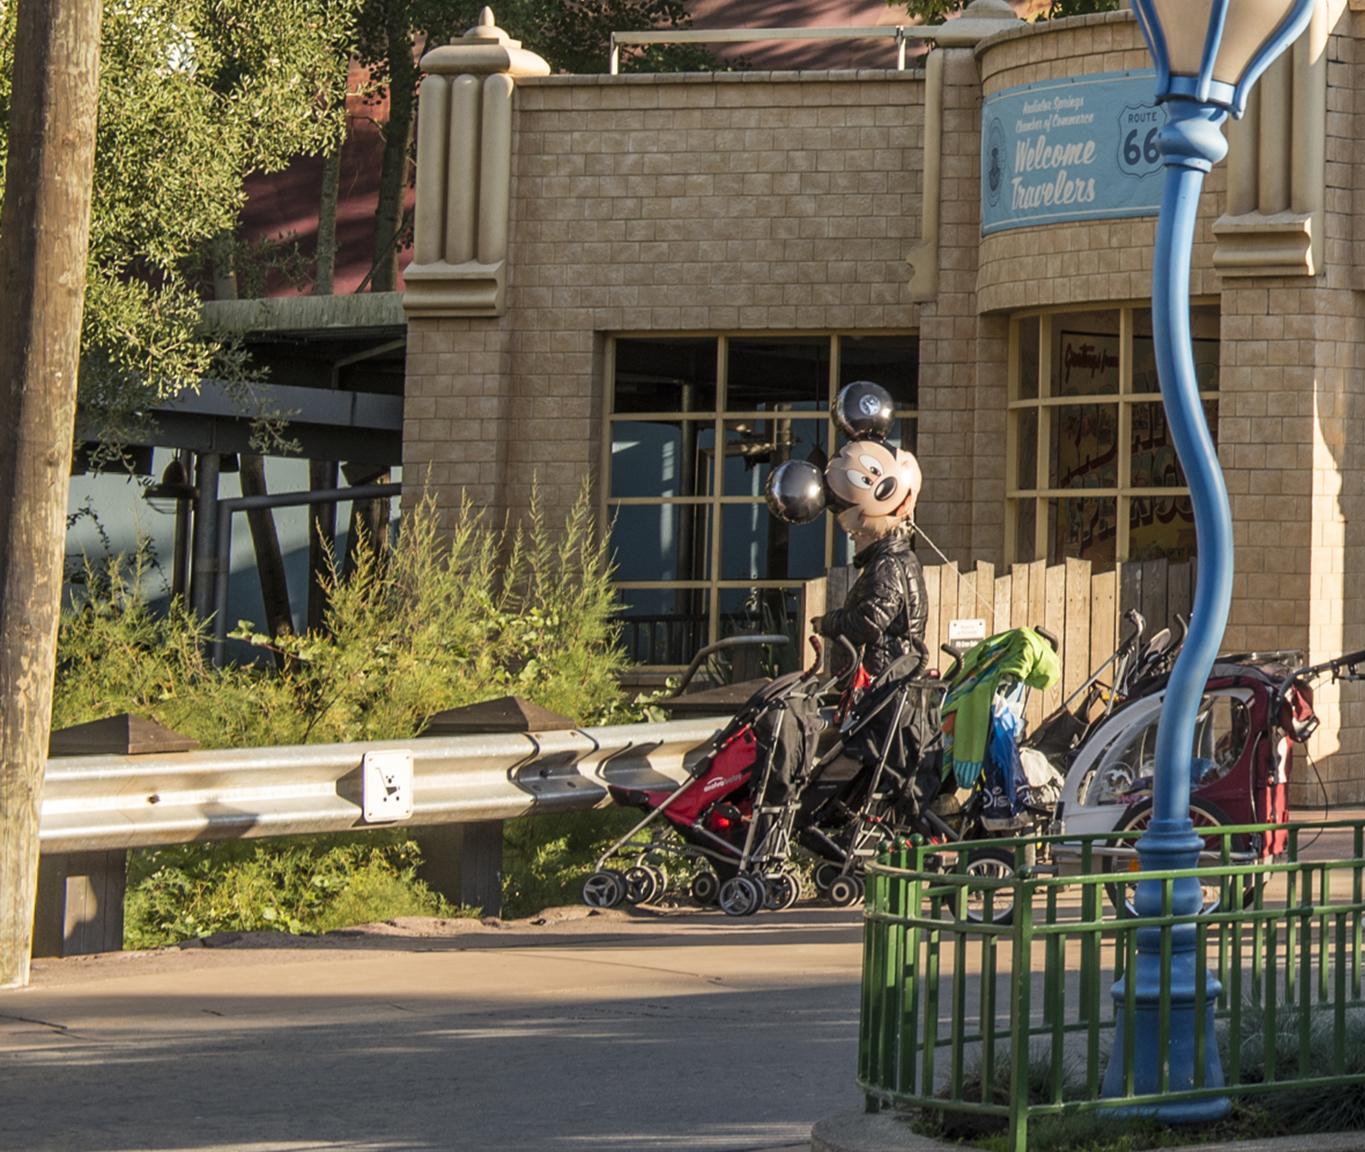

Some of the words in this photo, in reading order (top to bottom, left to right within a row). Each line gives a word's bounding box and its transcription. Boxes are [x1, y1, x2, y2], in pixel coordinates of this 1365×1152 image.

[1128, 110, 1158, 124] ROUTE
[1014, 134, 1098, 174] Welcome
[1123, 126, 1161, 166] 66
[1010, 169, 1096, 211] Travelers
